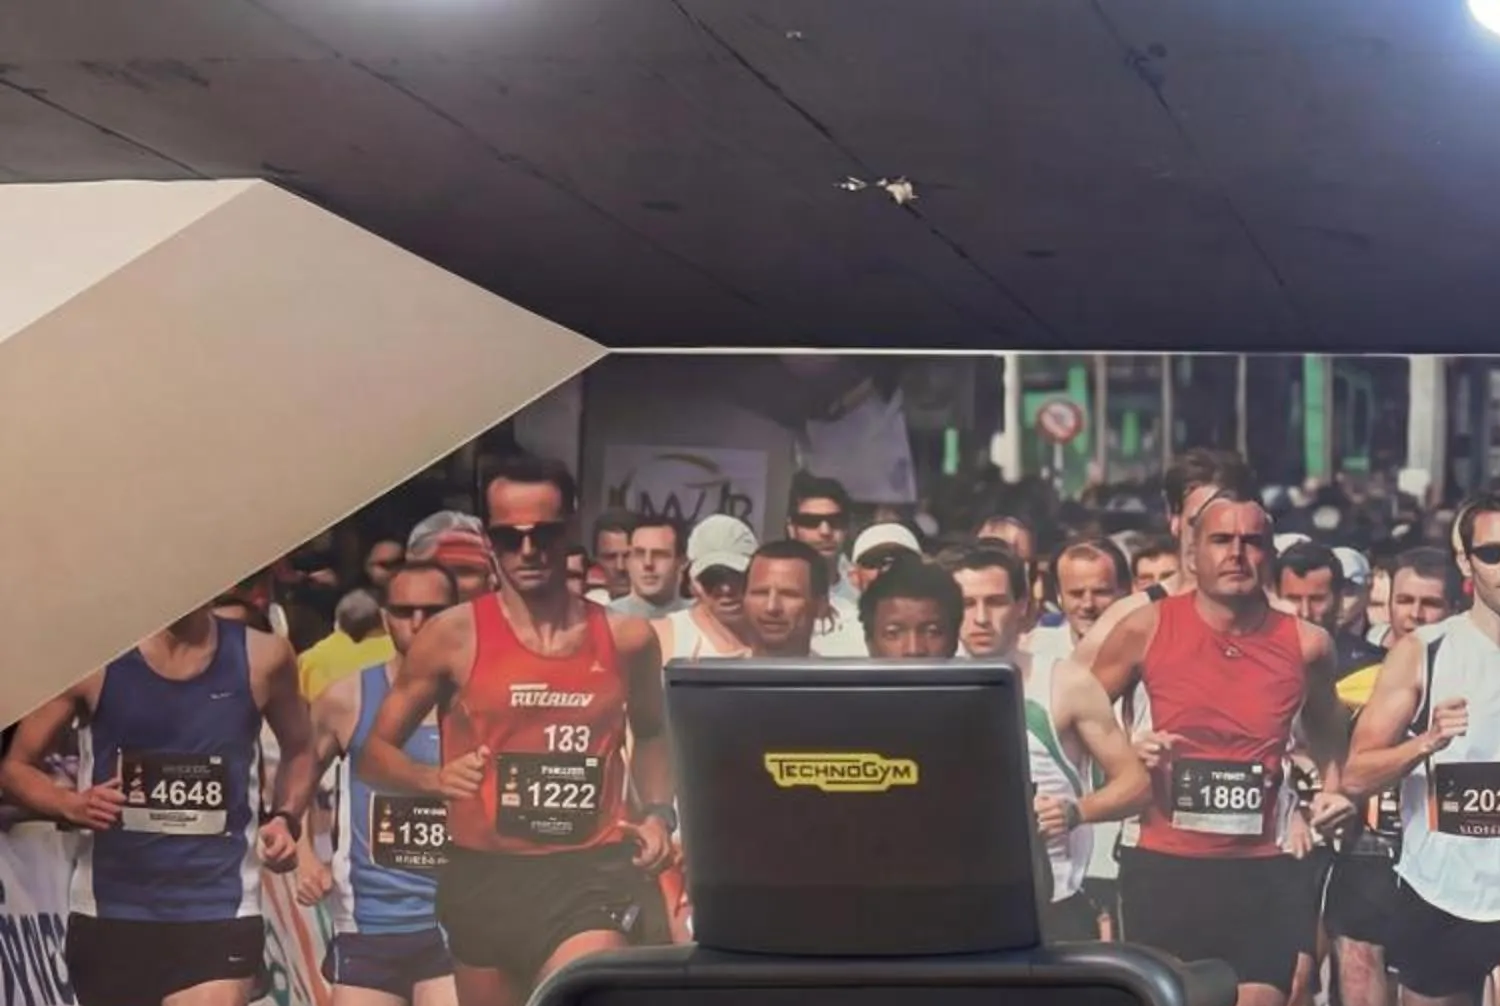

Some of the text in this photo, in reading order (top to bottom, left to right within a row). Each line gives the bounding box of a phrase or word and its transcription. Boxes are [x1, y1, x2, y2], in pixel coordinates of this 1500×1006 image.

[150, 779, 223, 807] 4648
[528, 781, 596, 809] 1222
[1200, 784, 1262, 810] 1880
